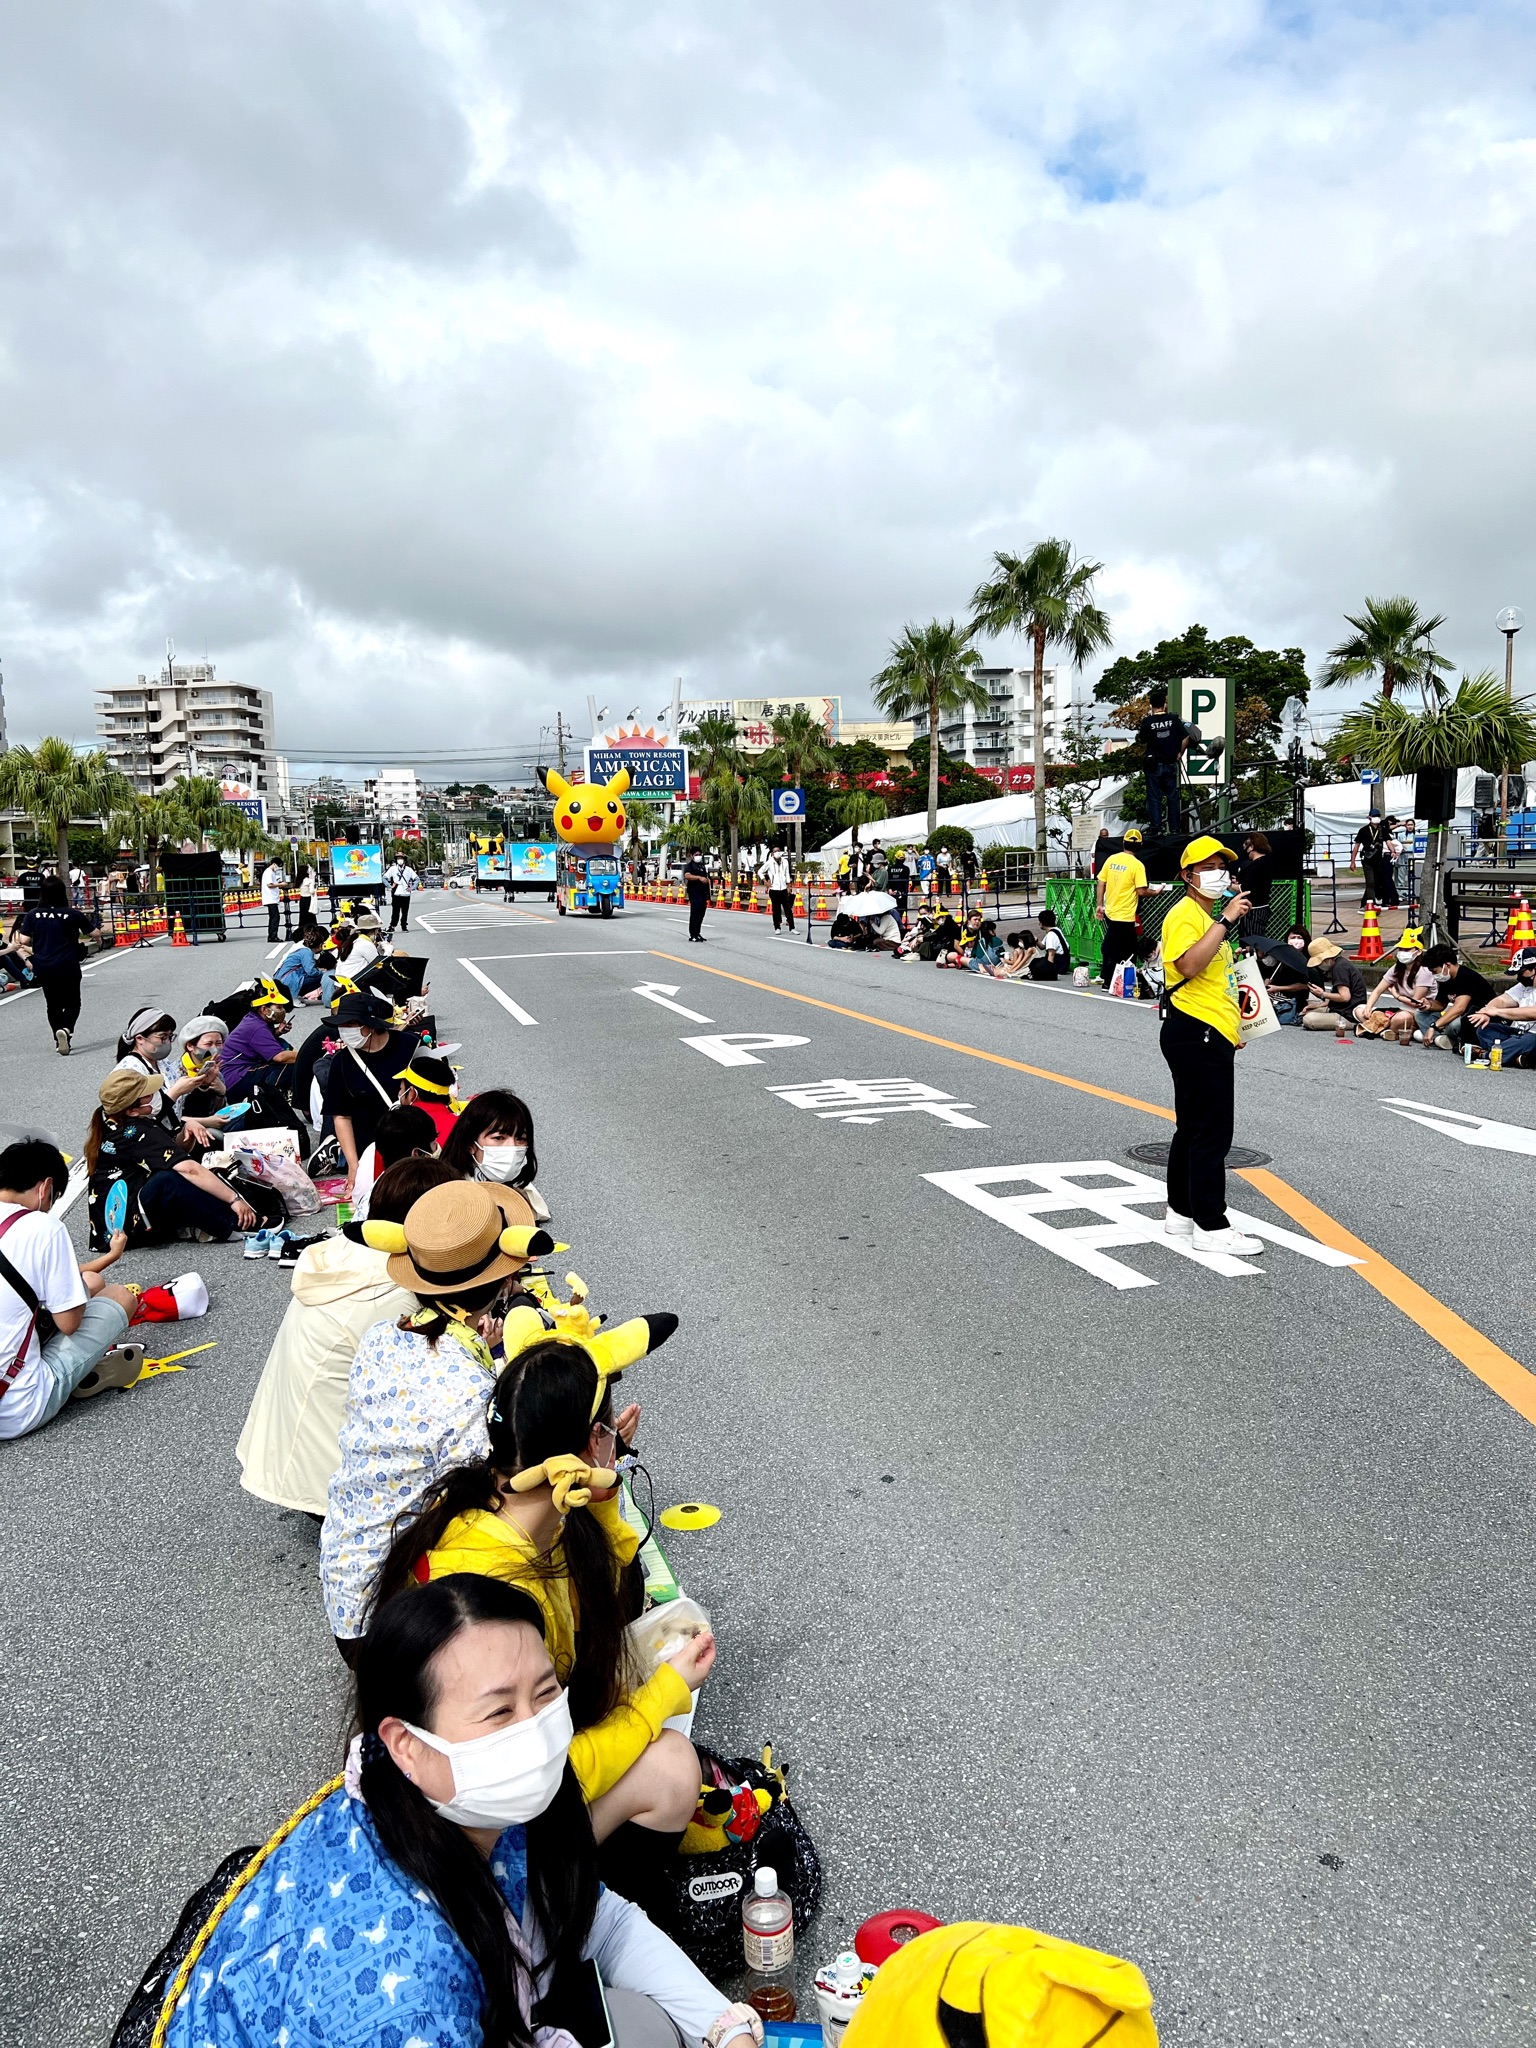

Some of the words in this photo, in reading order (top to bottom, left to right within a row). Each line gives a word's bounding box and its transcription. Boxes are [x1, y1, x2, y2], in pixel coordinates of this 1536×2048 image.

[1192, 689, 1216, 725] P
[1150, 720, 1173, 730] STAFF
[594, 760, 681, 773] AMERICAN
[602, 774, 675, 787] VLAGE
[922, 860, 932, 871] 28
[1109, 863, 1128, 872] STAFF
[1241, 1024, 1253, 1032] KEEP
[1253, 1017, 1269, 1028] QUIET
[692, 1877, 739, 1896] OUTDOOR
